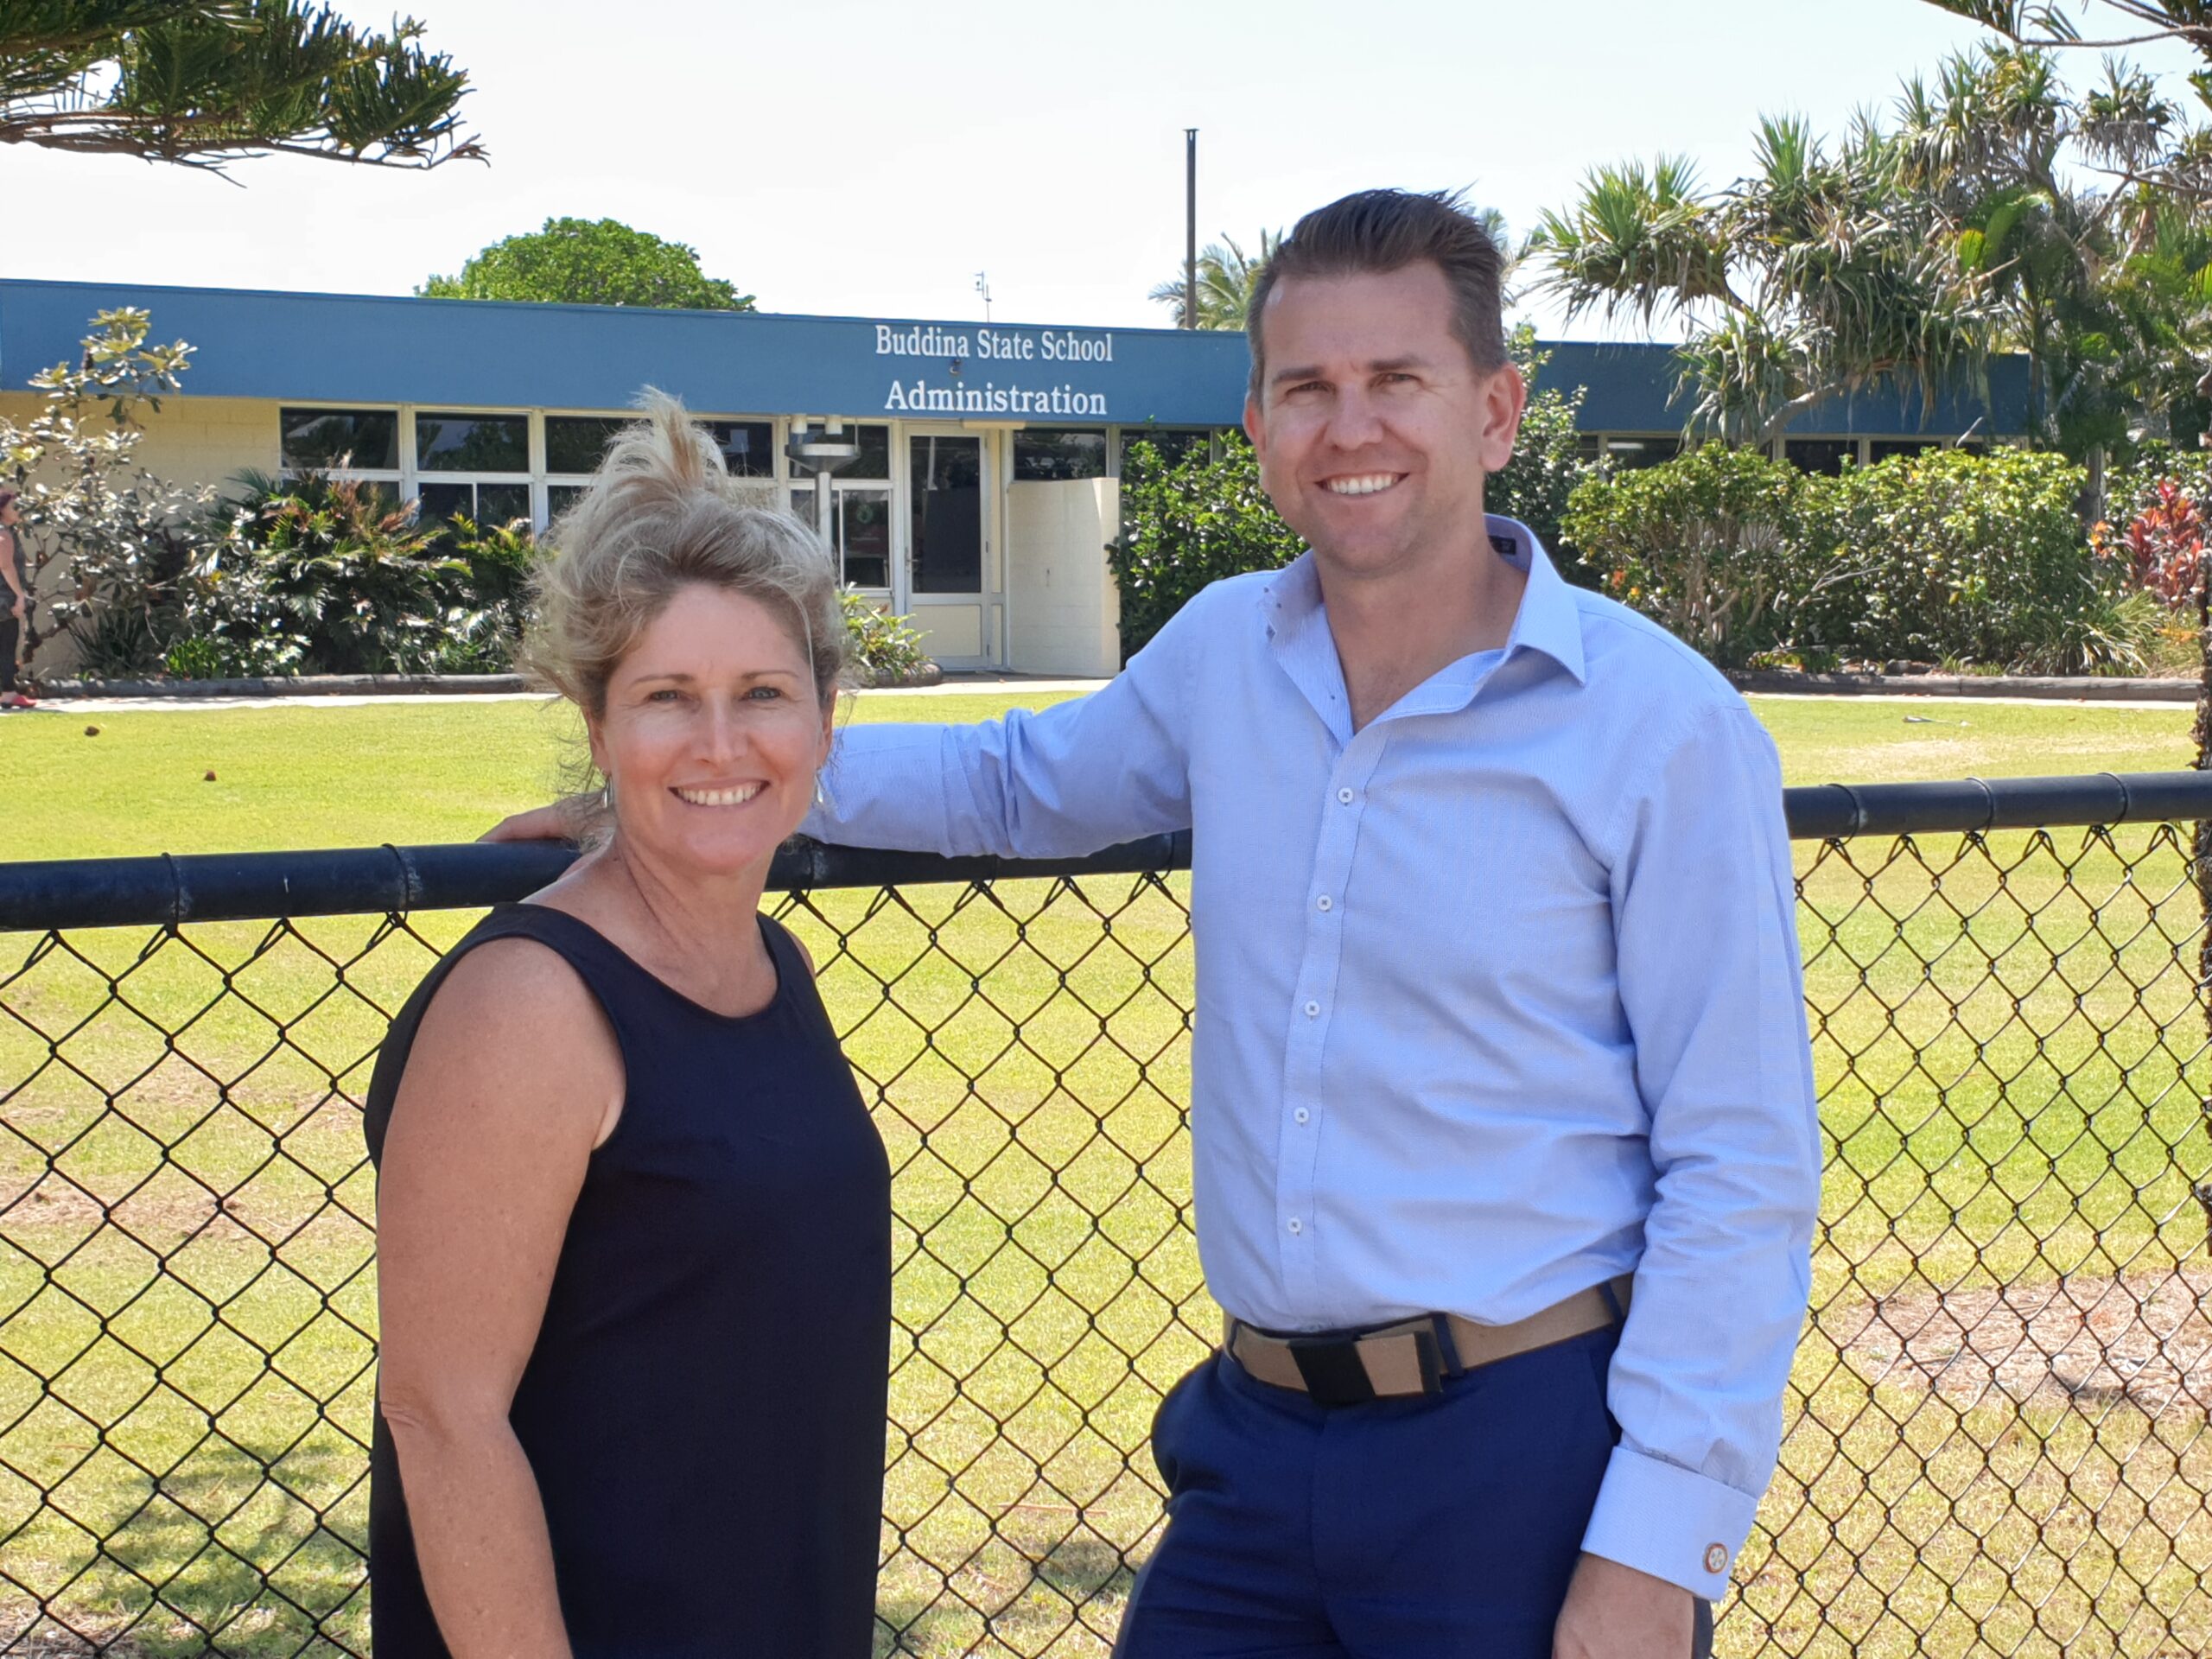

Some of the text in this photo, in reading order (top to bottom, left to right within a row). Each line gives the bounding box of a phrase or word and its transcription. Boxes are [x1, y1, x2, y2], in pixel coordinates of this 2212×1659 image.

[875, 325, 1113, 361] Buddina State School
[884, 380, 1107, 415] Administration
